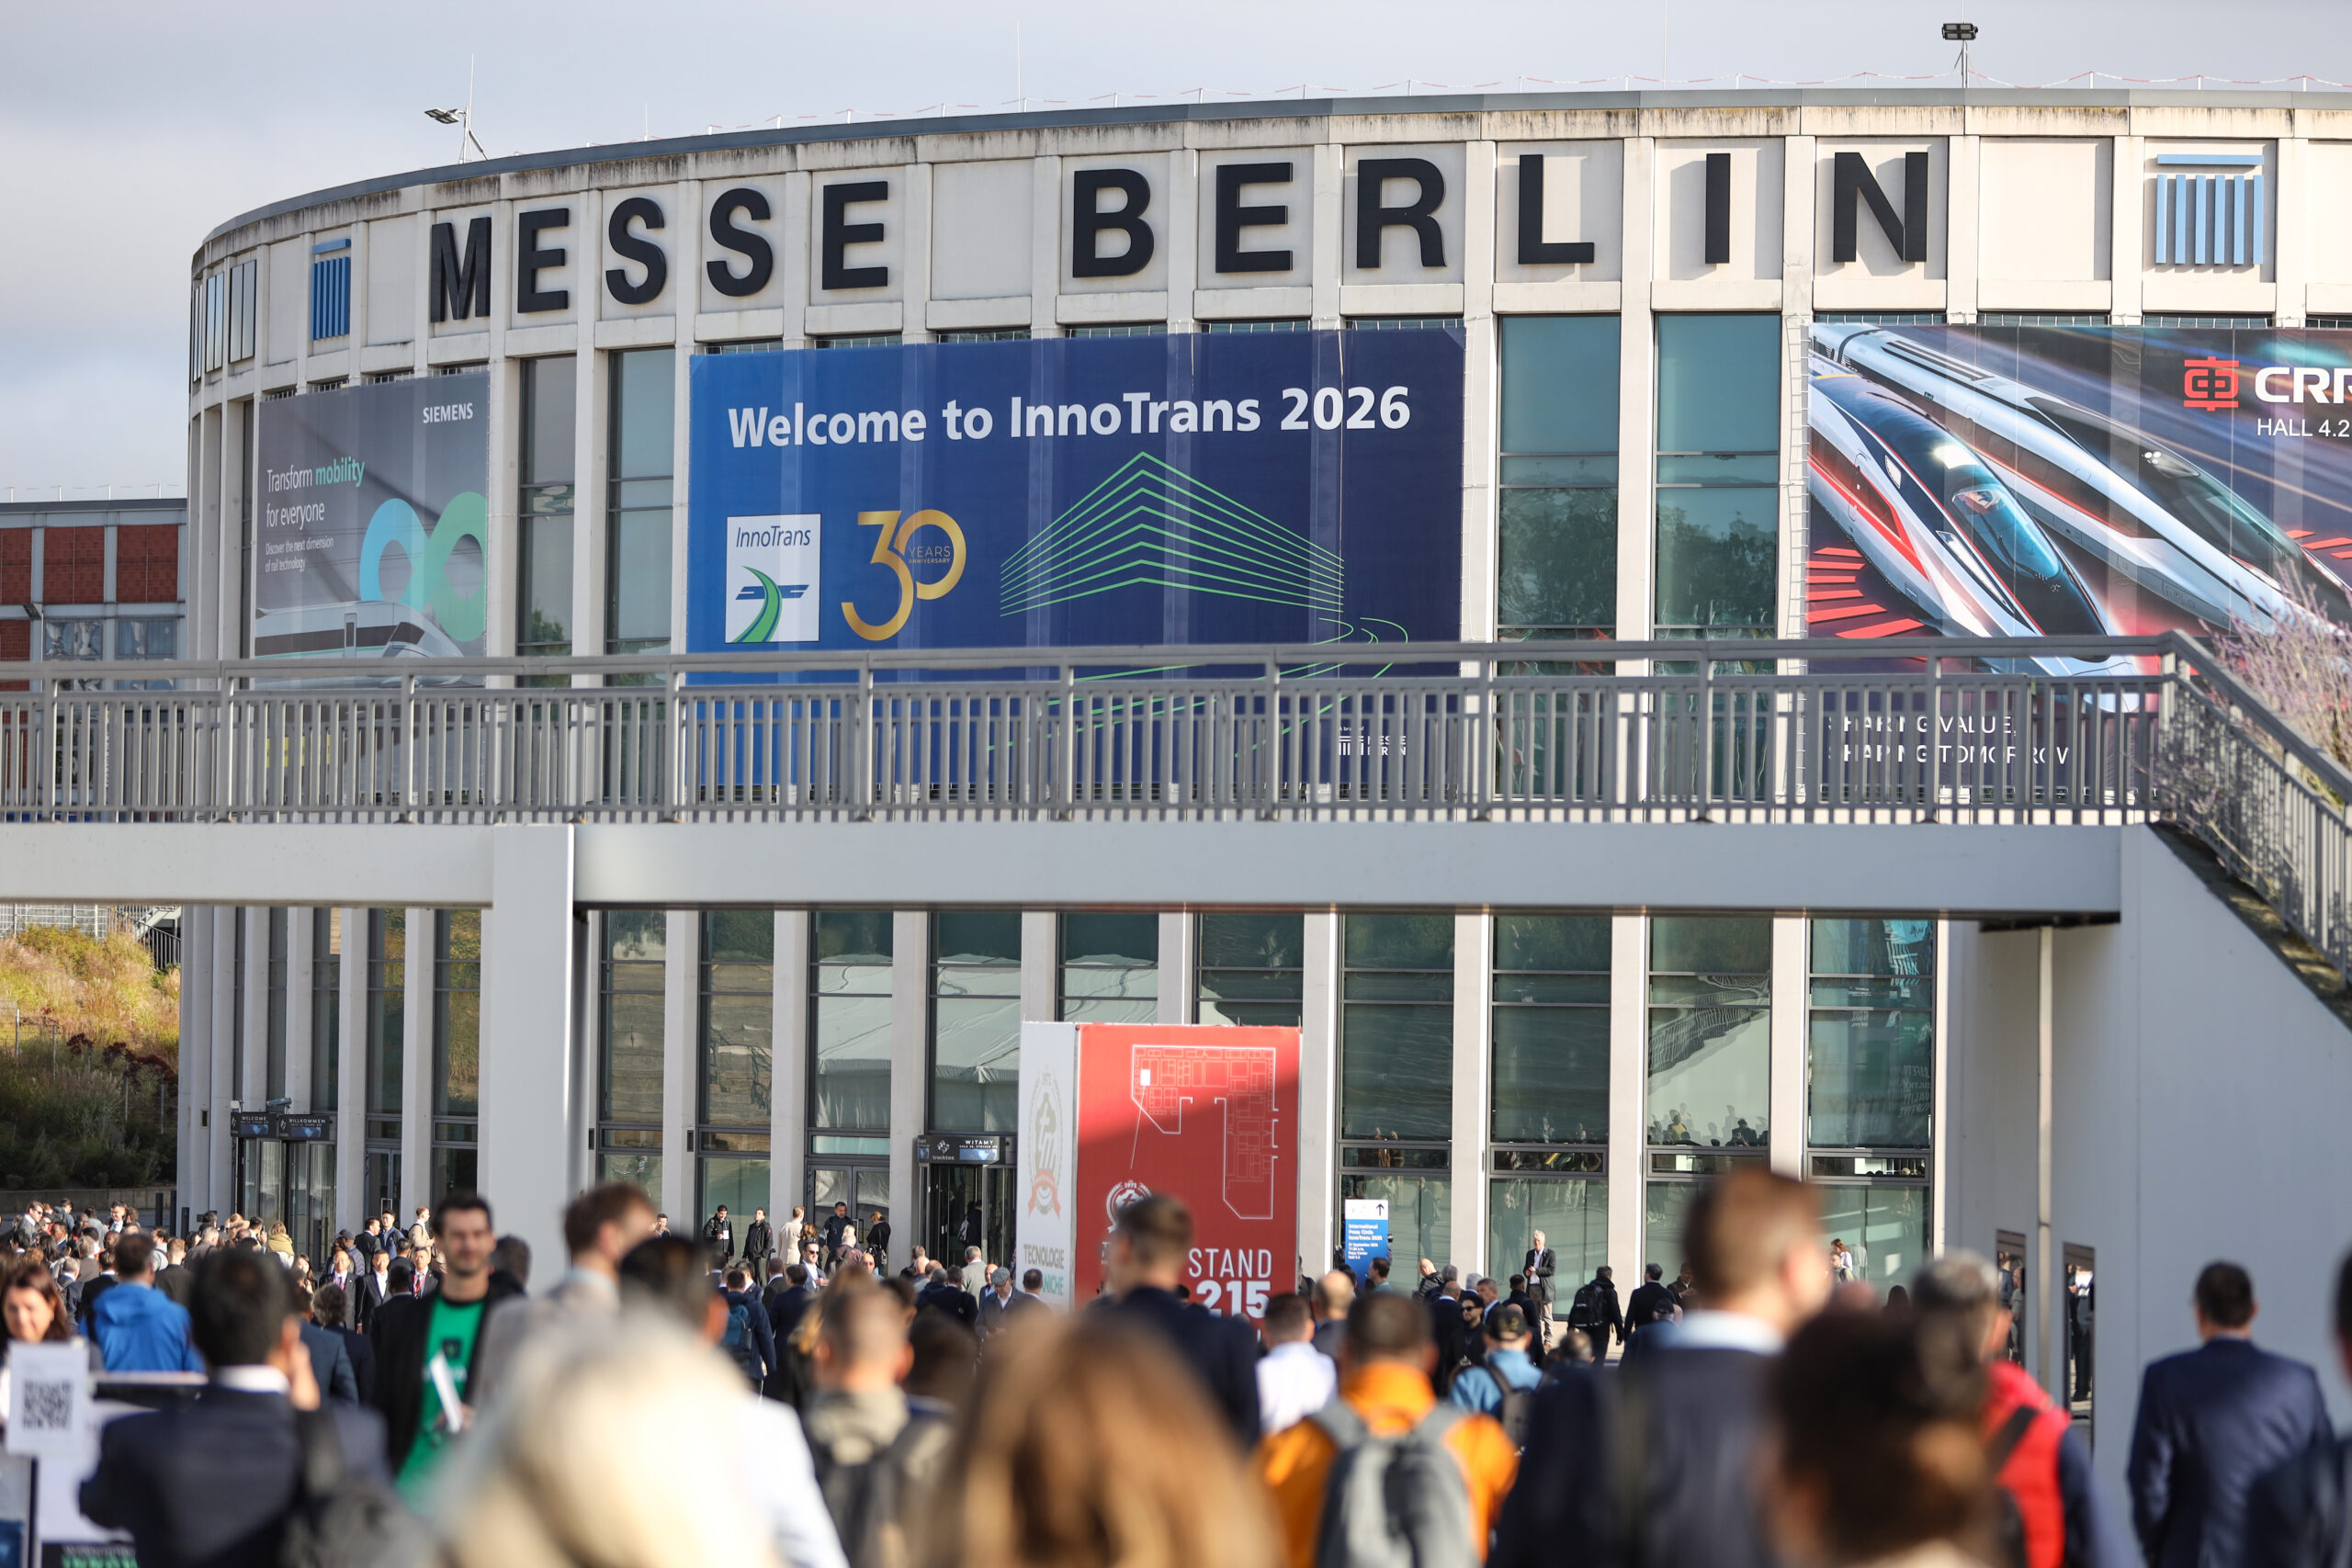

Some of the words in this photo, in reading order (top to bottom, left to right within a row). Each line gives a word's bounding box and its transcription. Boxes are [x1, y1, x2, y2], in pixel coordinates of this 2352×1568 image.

[430, 180, 888, 323] MESSE
[1071, 152, 1928, 278] BERLIN
[423, 402, 473, 423] SIEMENS
[728, 401, 927, 448] Welcome
[942, 399, 993, 441] to
[1011, 391, 1260, 438] InnoTrans
[1281, 386, 1412, 432] 2026
[2256, 418, 2313, 437] HALL
[2318, 419, 2350, 438] 4.2
[266, 464, 313, 492] Transform
[315, 456, 365, 487] mobility
[266, 502, 279, 528] for
[280, 502, 325, 530] everyone
[266, 542, 285, 555] Discover
[285, 539, 294, 553] the
[294, 539, 306, 551] next
[306, 536, 334, 550] dimension
[736, 525, 811, 548] InnoTrans
[278, 556, 307, 572] technology
[909, 546, 951, 558] YEARS
[841, 509, 967, 641] 30
[1023, 1244, 1065, 1269] TECNOLOGIE
[1188, 1247, 1272, 1279] STAND
[1196, 1280, 1272, 1319] 215
